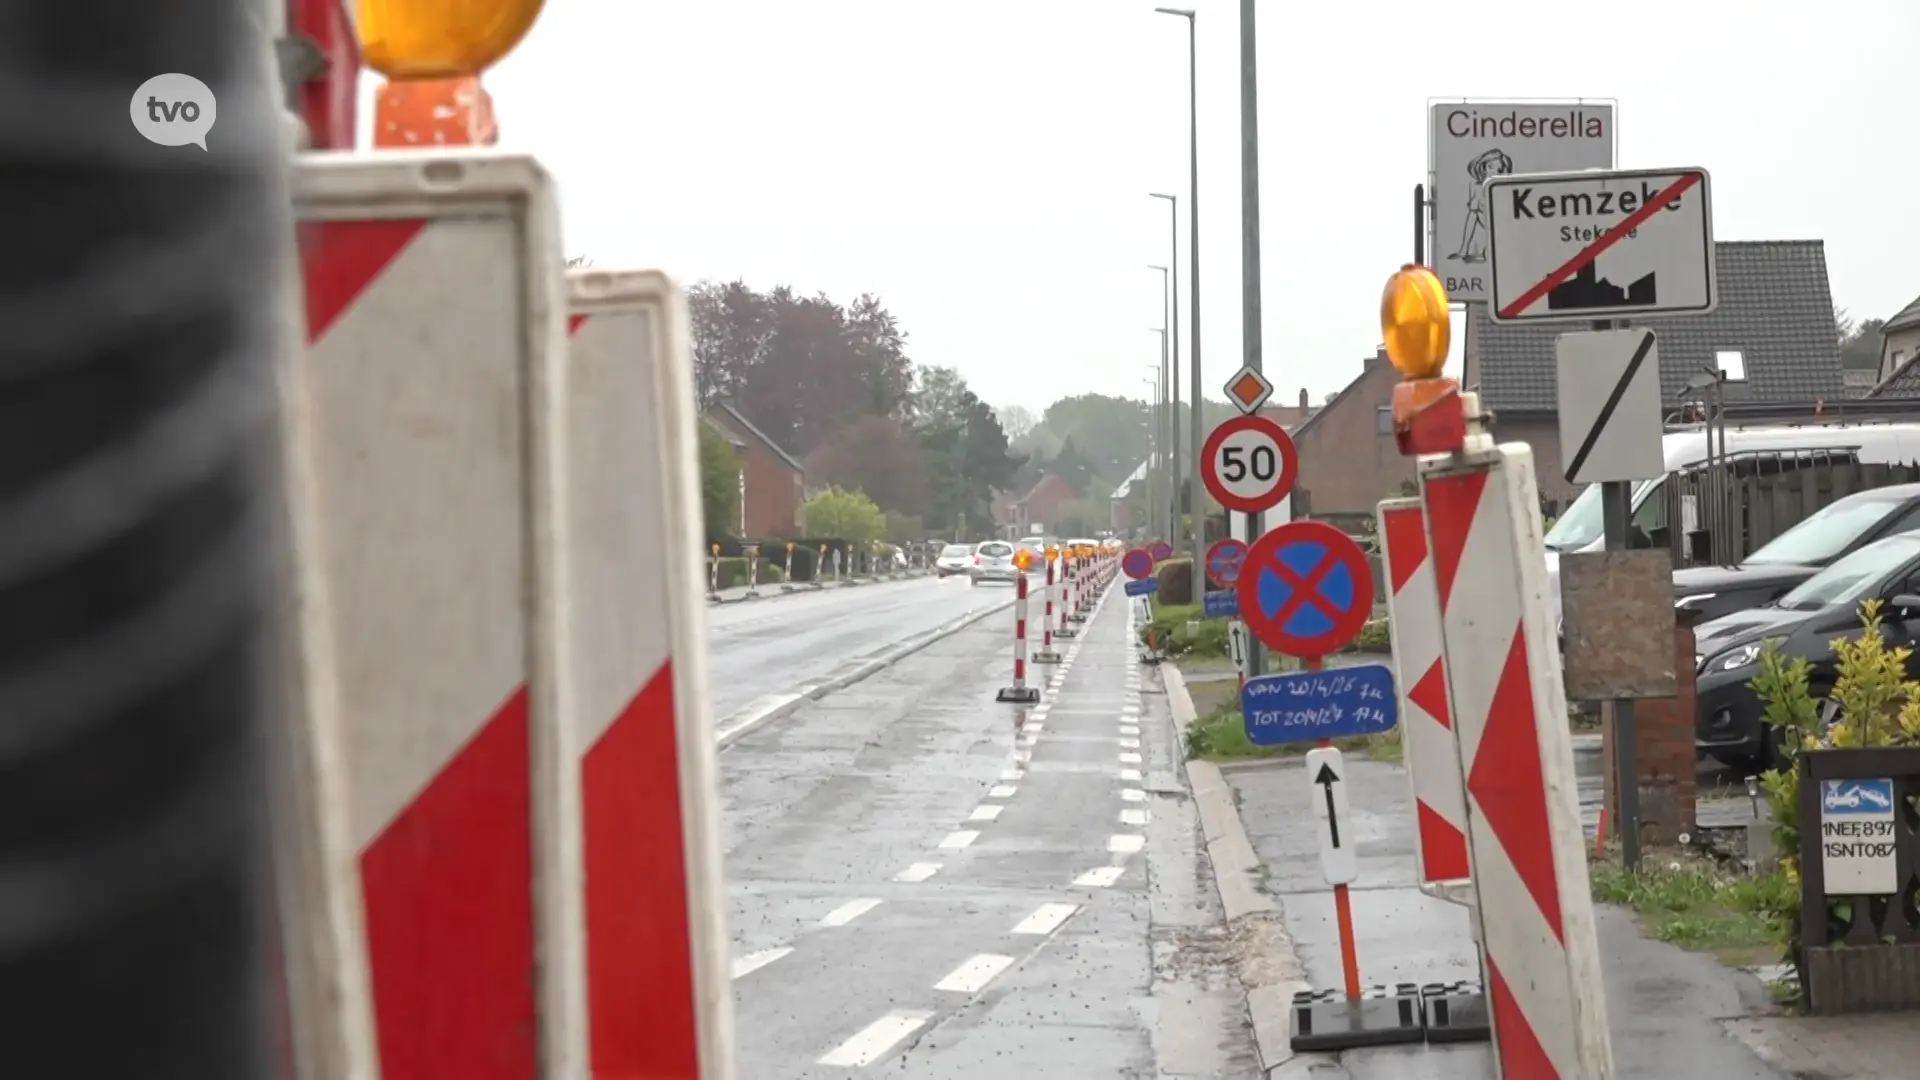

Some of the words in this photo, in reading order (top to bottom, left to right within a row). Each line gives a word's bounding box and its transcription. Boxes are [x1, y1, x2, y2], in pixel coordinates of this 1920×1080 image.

[1447, 110, 1603, 138] Cinderella
[1560, 224, 1638, 243] Steke
[1446, 277, 1484, 292] BAR
[1222, 445, 1276, 482] 50
[1252, 710, 1282, 726] TOT
